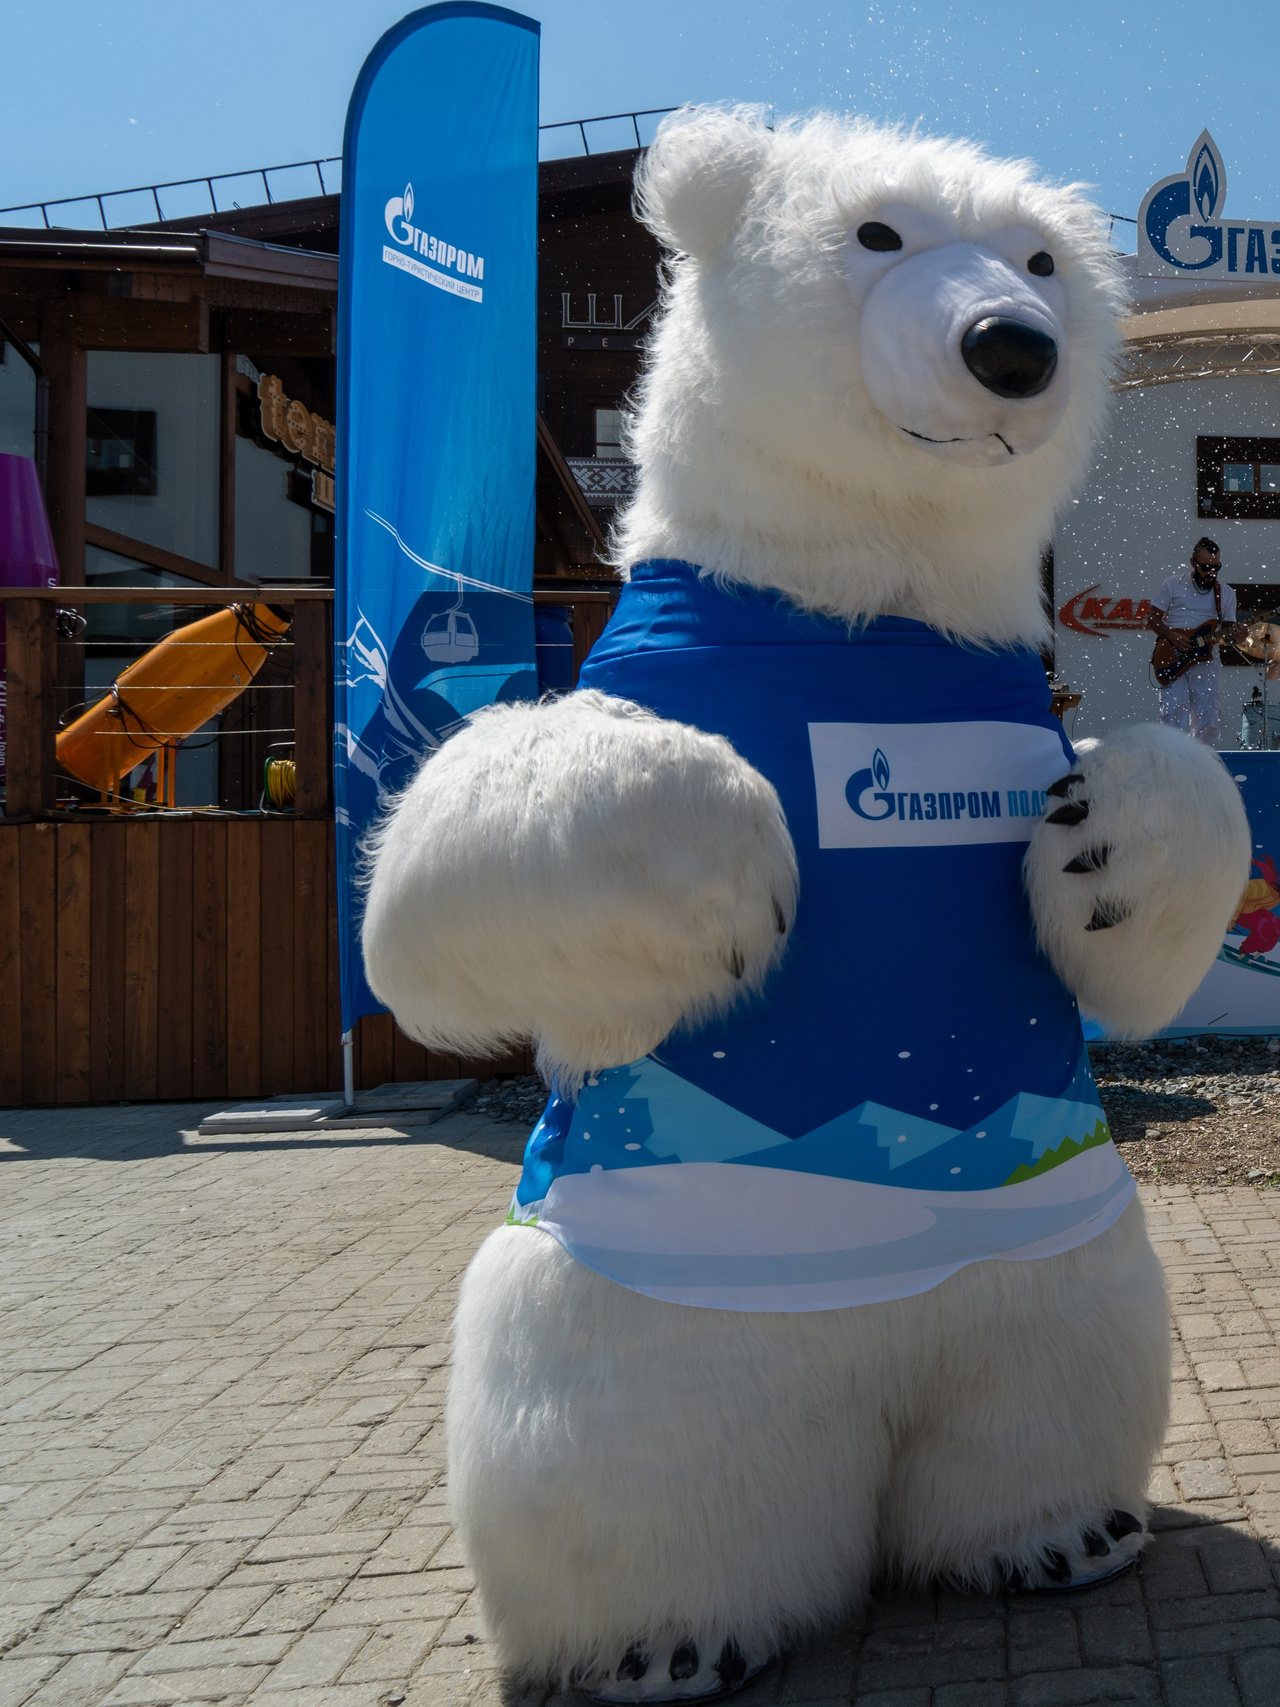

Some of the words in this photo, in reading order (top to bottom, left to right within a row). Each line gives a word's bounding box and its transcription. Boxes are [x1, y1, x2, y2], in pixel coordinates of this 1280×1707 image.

[413, 227, 485, 280] ГАЗПРОМ
[456, 284, 480, 298] ЦЕНТР
[897, 790, 1001, 821] ГАЗПРОМ
